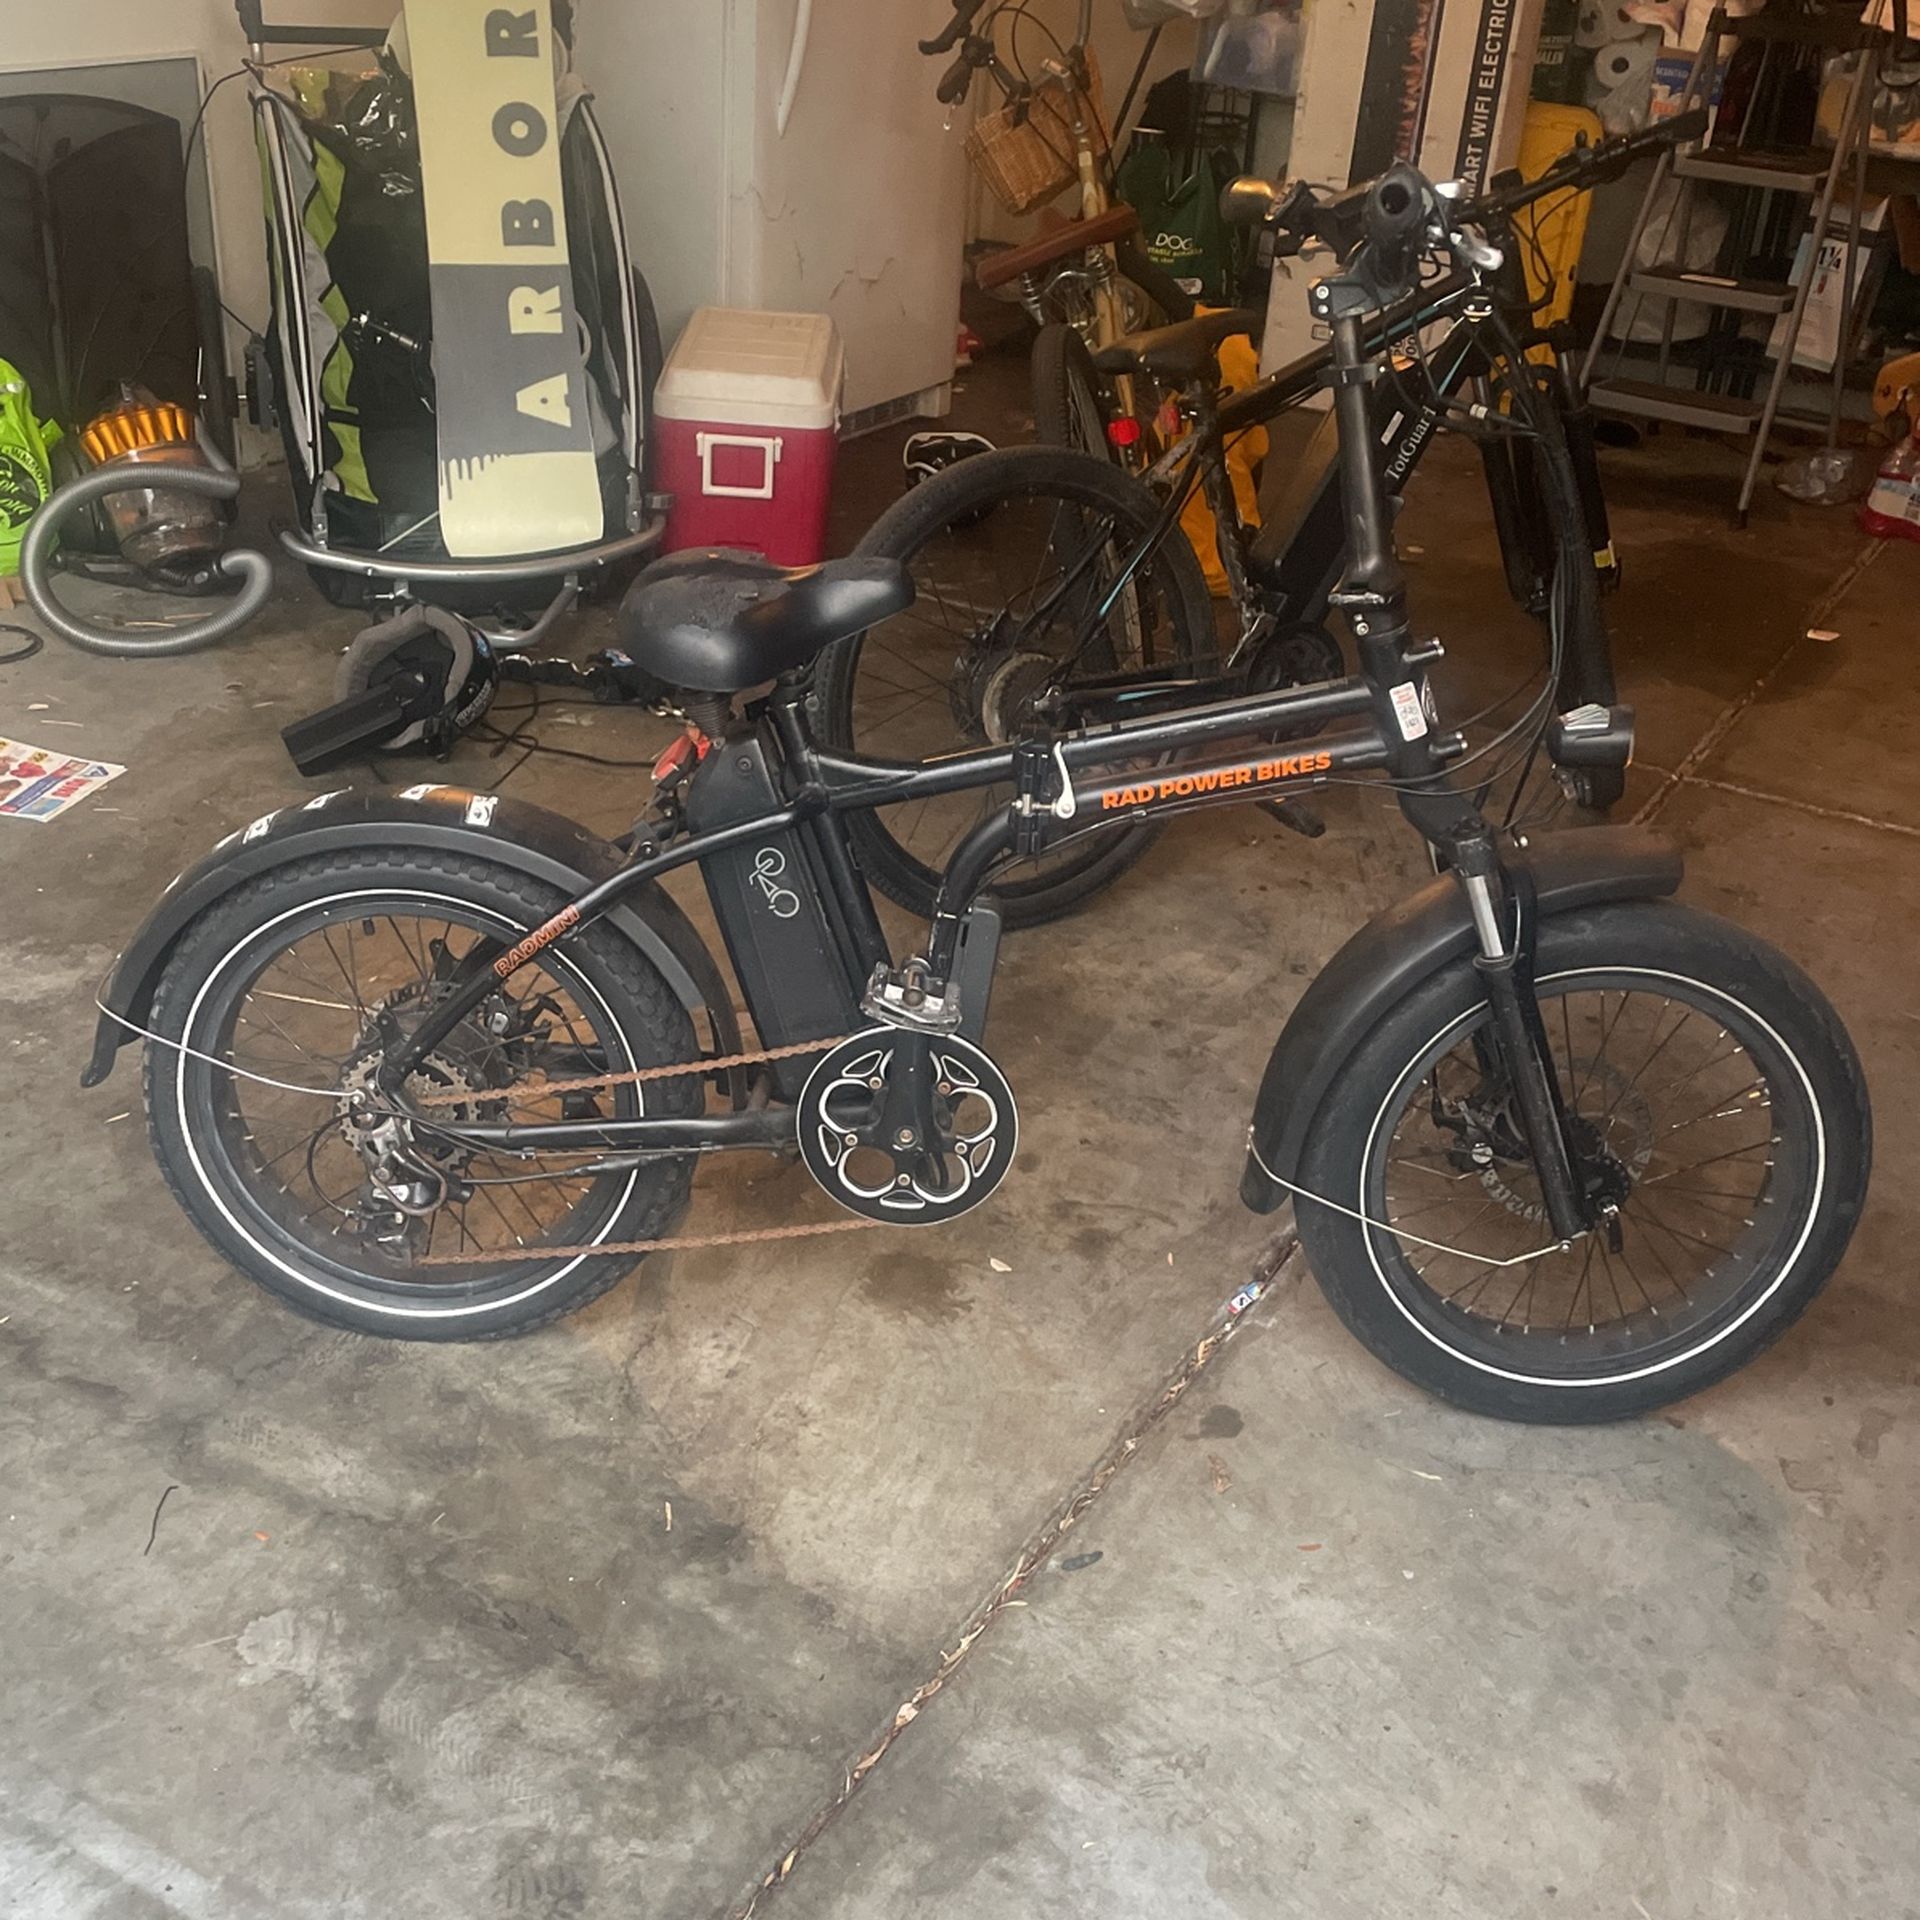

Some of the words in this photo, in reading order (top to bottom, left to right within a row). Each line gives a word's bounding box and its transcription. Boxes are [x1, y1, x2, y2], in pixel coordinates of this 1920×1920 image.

[1469, 96, 1492, 138] WIFI
[485, 8, 572, 428] ARBOR
[1102, 786, 1155, 810] RAD
[1160, 767, 1251, 799] POWER
[1257, 752, 1331, 782] BIKES
[493, 903, 580, 977] RADMINI
